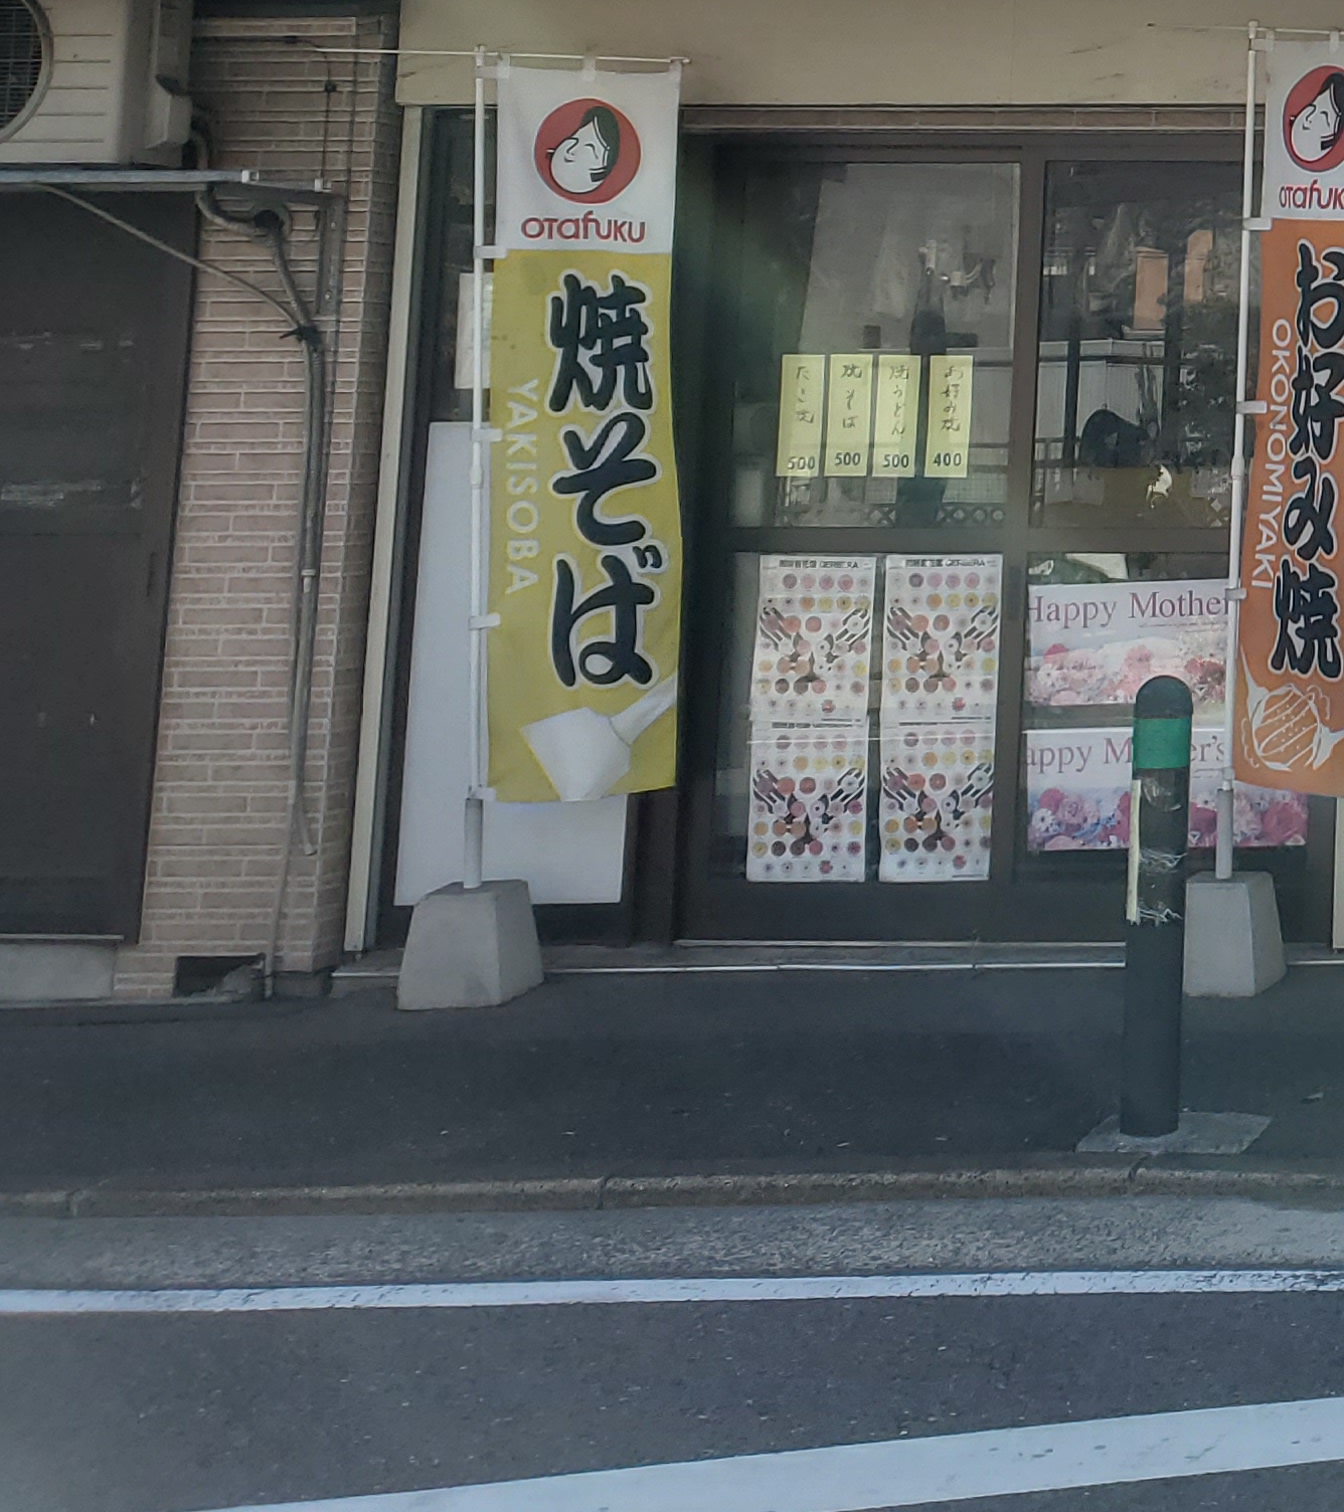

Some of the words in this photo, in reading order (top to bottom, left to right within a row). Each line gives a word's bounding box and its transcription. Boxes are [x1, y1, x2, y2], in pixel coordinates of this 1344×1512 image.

[787, 455, 816, 471] 500
[834, 451, 861, 467] 500
[882, 453, 910, 468] 500
[932, 452, 962, 467] 400
[1252, 319, 1291, 589] OKONOMIYAKI
[506, 377, 539, 595] YAKISOBA
[547, 272, 664, 688] 焼そば
[1028, 595, 1117, 628] Happy
[1027, 746, 1092, 774] appy
